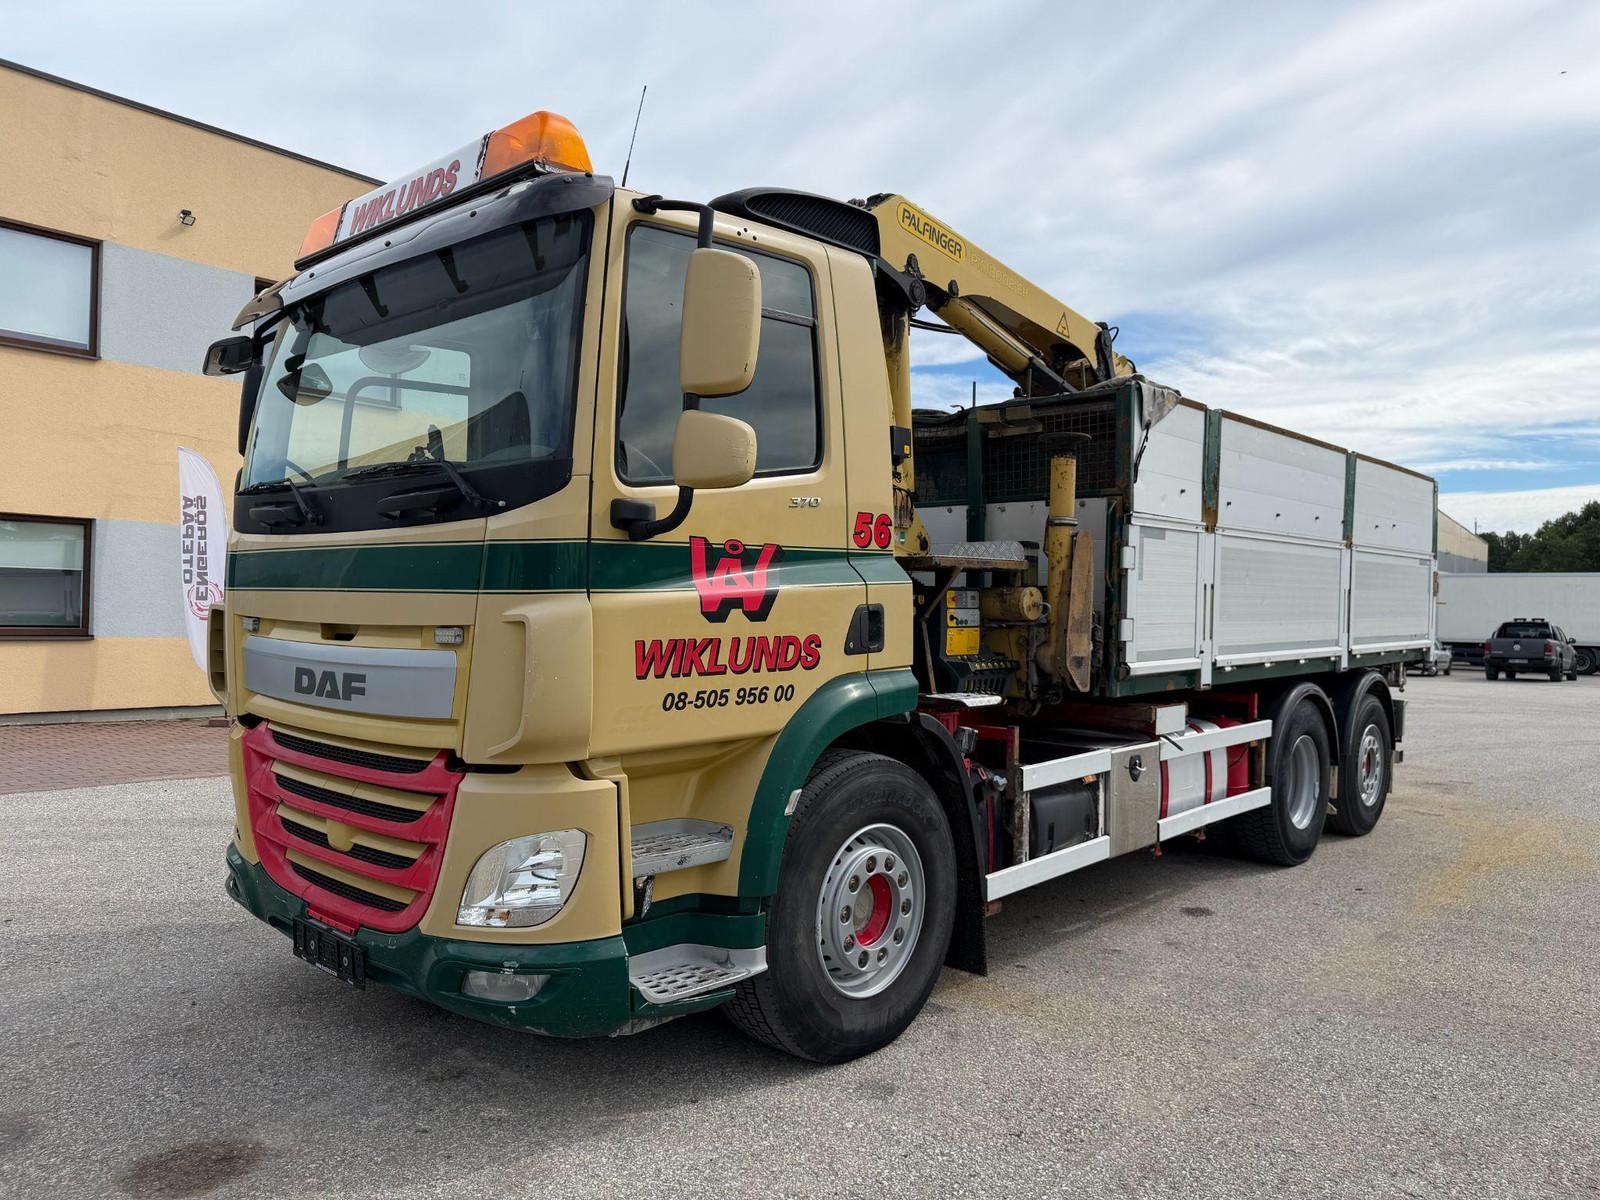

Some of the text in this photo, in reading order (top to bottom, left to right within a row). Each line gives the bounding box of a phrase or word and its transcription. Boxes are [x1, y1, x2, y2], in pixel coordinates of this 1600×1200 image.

[349, 159, 461, 235] WIKLUNDS
[901, 207, 963, 259] PALFINGER
[788, 497, 822, 509] 370
[852, 511, 893, 549] 56
[634, 633, 822, 680] WIKLUNDS
[294, 666, 367, 701] DAF
[662, 684, 795, 712] 08-505 956 00
